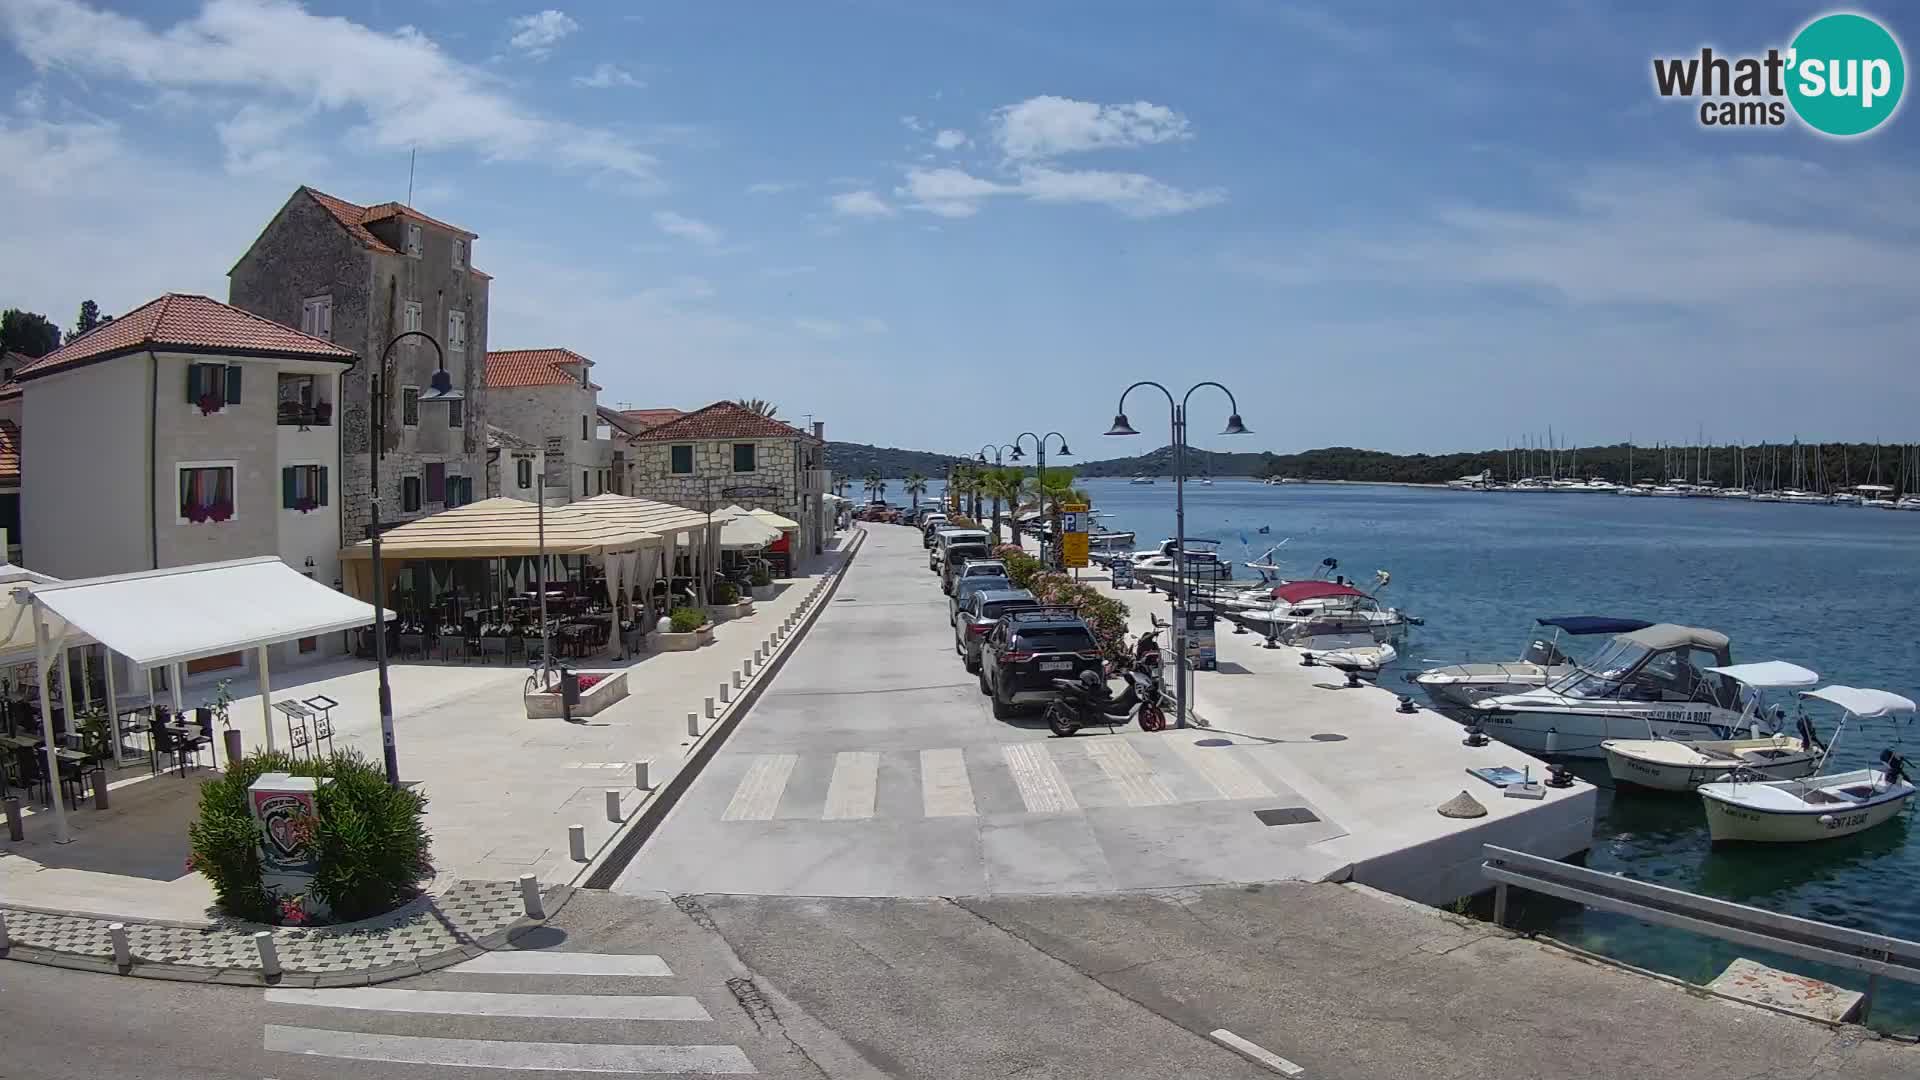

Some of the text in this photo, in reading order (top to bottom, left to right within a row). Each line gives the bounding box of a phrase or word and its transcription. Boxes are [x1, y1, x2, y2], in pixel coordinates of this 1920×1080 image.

[1064, 514, 1075, 531] P
[1666, 710, 1686, 721] RENT
[1693, 711, 1712, 723] BOAT
